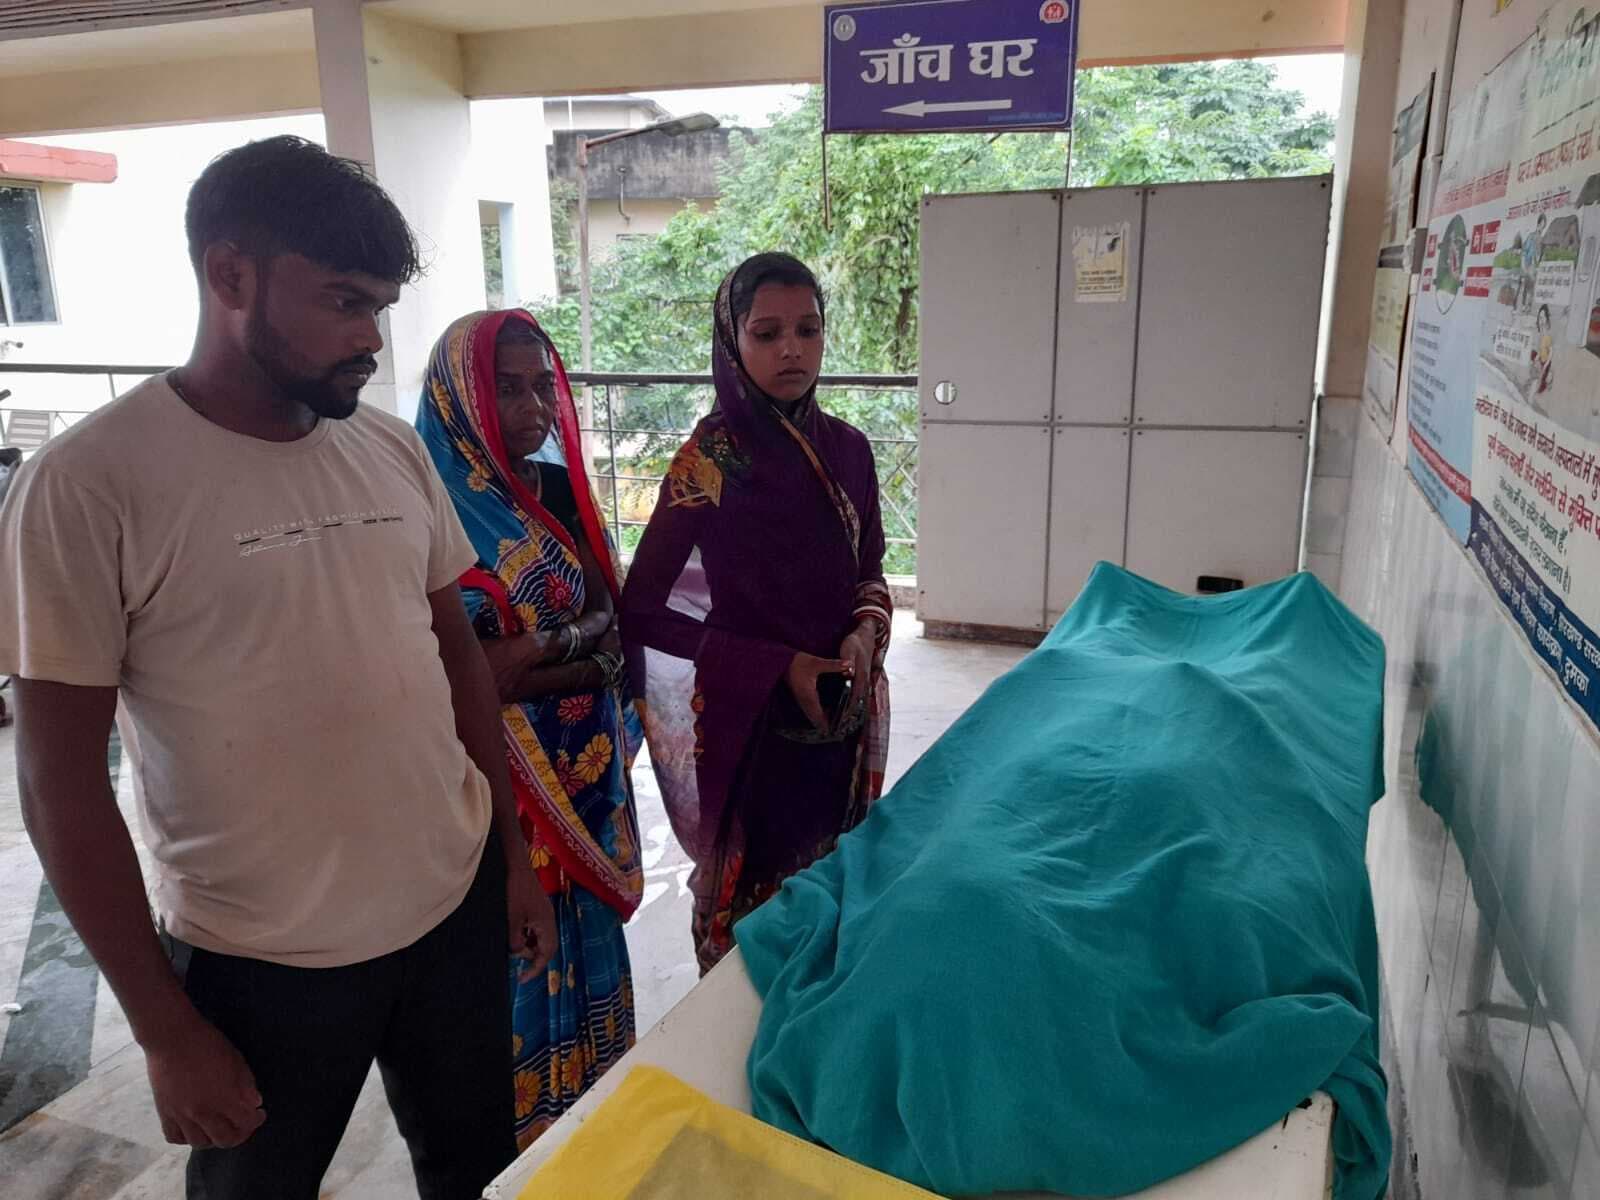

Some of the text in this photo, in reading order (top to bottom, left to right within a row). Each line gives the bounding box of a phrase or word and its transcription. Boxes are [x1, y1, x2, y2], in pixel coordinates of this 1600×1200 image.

[859, 33, 1038, 85] जाँच घर
[1558, 484, 1567, 514] से
[1568, 494, 1594, 533] मुक्ति
[1563, 656, 1590, 697] दुमका
